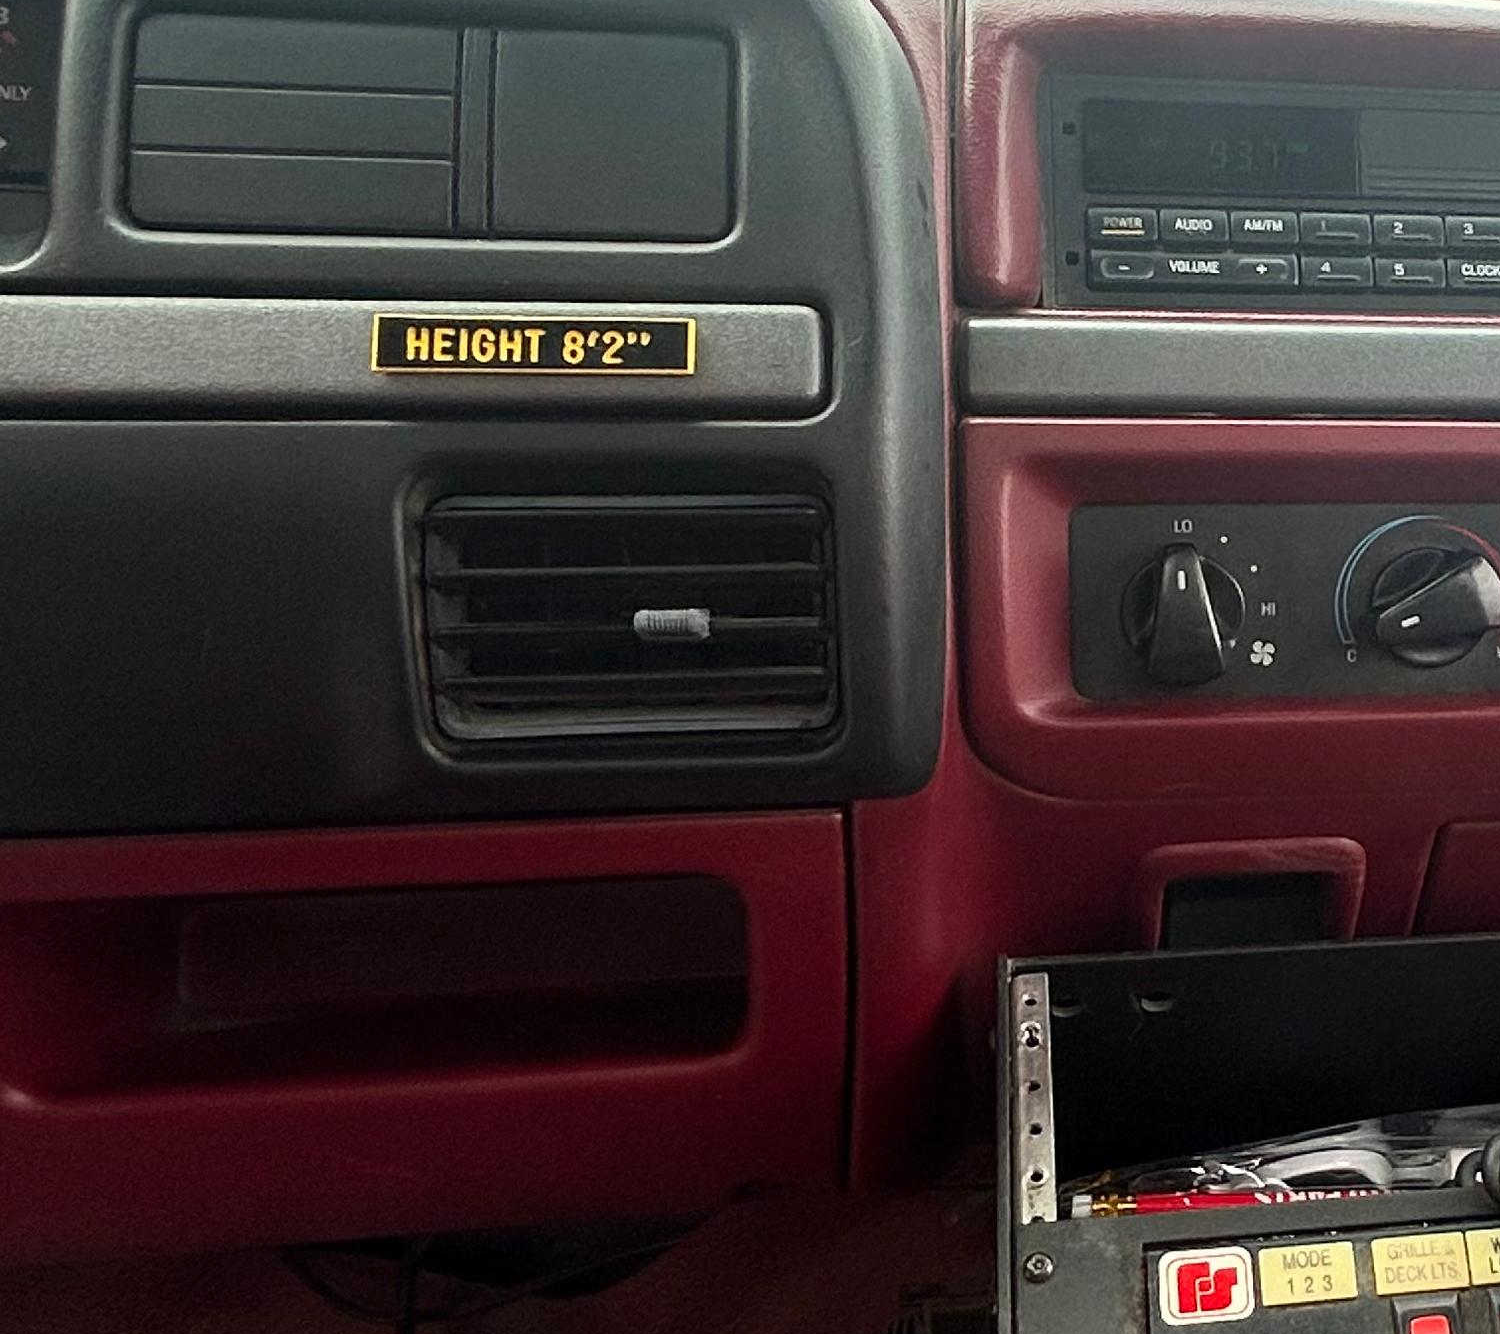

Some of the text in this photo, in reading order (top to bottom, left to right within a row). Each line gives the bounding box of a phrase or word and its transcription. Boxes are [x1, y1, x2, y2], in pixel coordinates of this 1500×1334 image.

[0, 84, 32, 101] NLY
[1103, 217, 1143, 229] POWER
[1174, 217, 1213, 231] AUDIO
[1243, 219, 1284, 232] AM/FM
[1392, 222, 1404, 234] 2
[1463, 223, 1474, 234] 3
[1168, 260, 1220, 274] VOLUME
[1319, 261, 1331, 273] 4
[1393, 264, 1405, 276] 5
[405, 326, 547, 364] HEIGHT
[1173, 519, 1193, 533] LO
[1260, 602, 1276, 617] HI
[1346, 648, 1358, 663] C
[1387, 1240, 1442, 1260] GRILLE
[1281, 1248, 1333, 1271] MODE
[1384, 1263, 1428, 1284] DECK
[1287, 1274, 1334, 1295] 1 2 3
